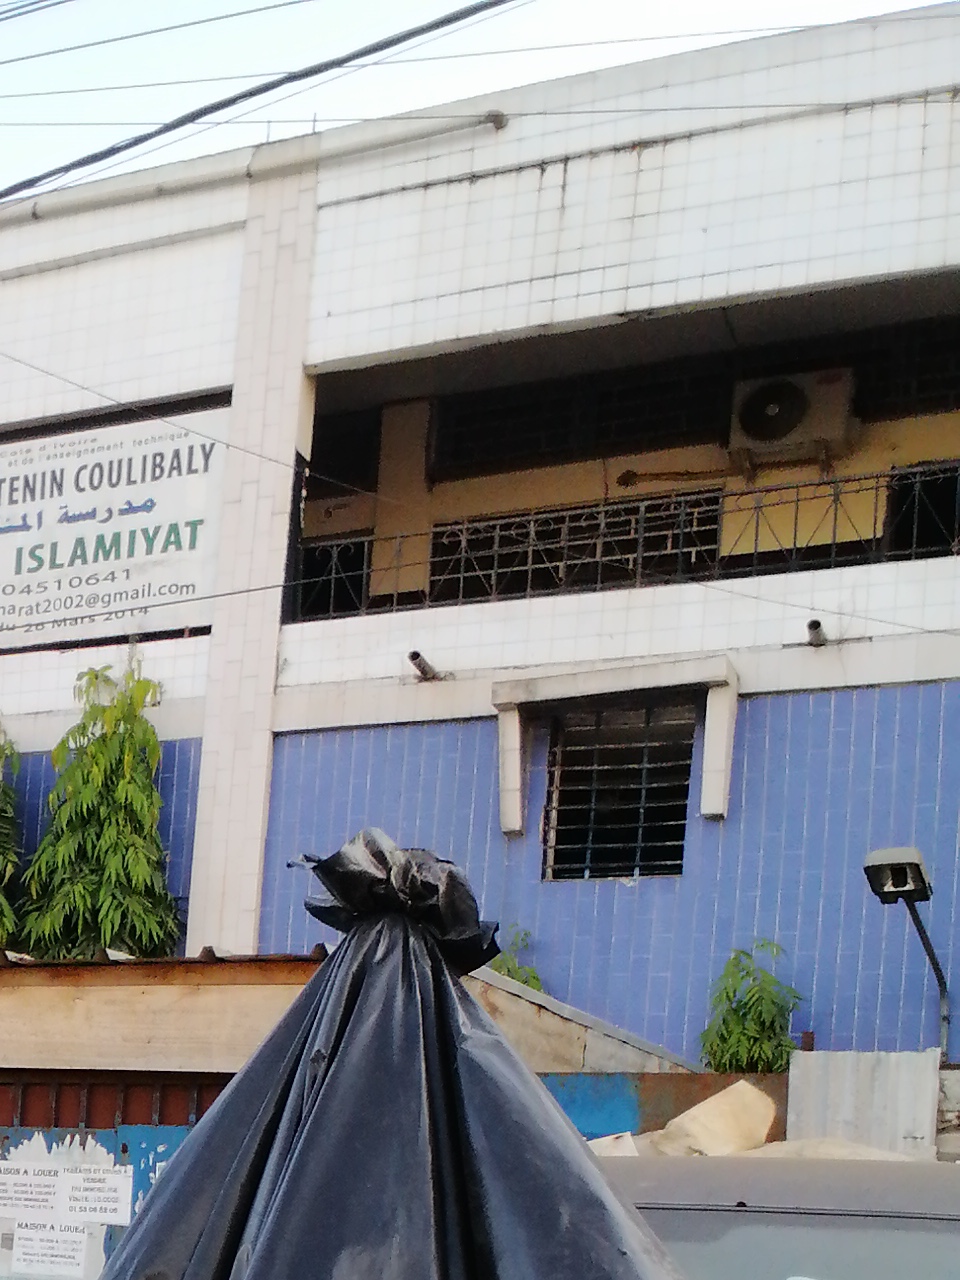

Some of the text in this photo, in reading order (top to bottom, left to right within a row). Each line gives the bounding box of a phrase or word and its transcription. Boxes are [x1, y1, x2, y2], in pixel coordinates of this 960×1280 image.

[74, 442, 216, 493] COULIBALY
[57, 497, 157, 525] مدرسة
[14, 519, 205, 576] ISLAMIYAT
[51, 613, 96, 630] Mars
[22, 1168, 29, 1176] A
[33, 1168, 59, 1178] LOUER
[49, 1223, 55, 1232] A
